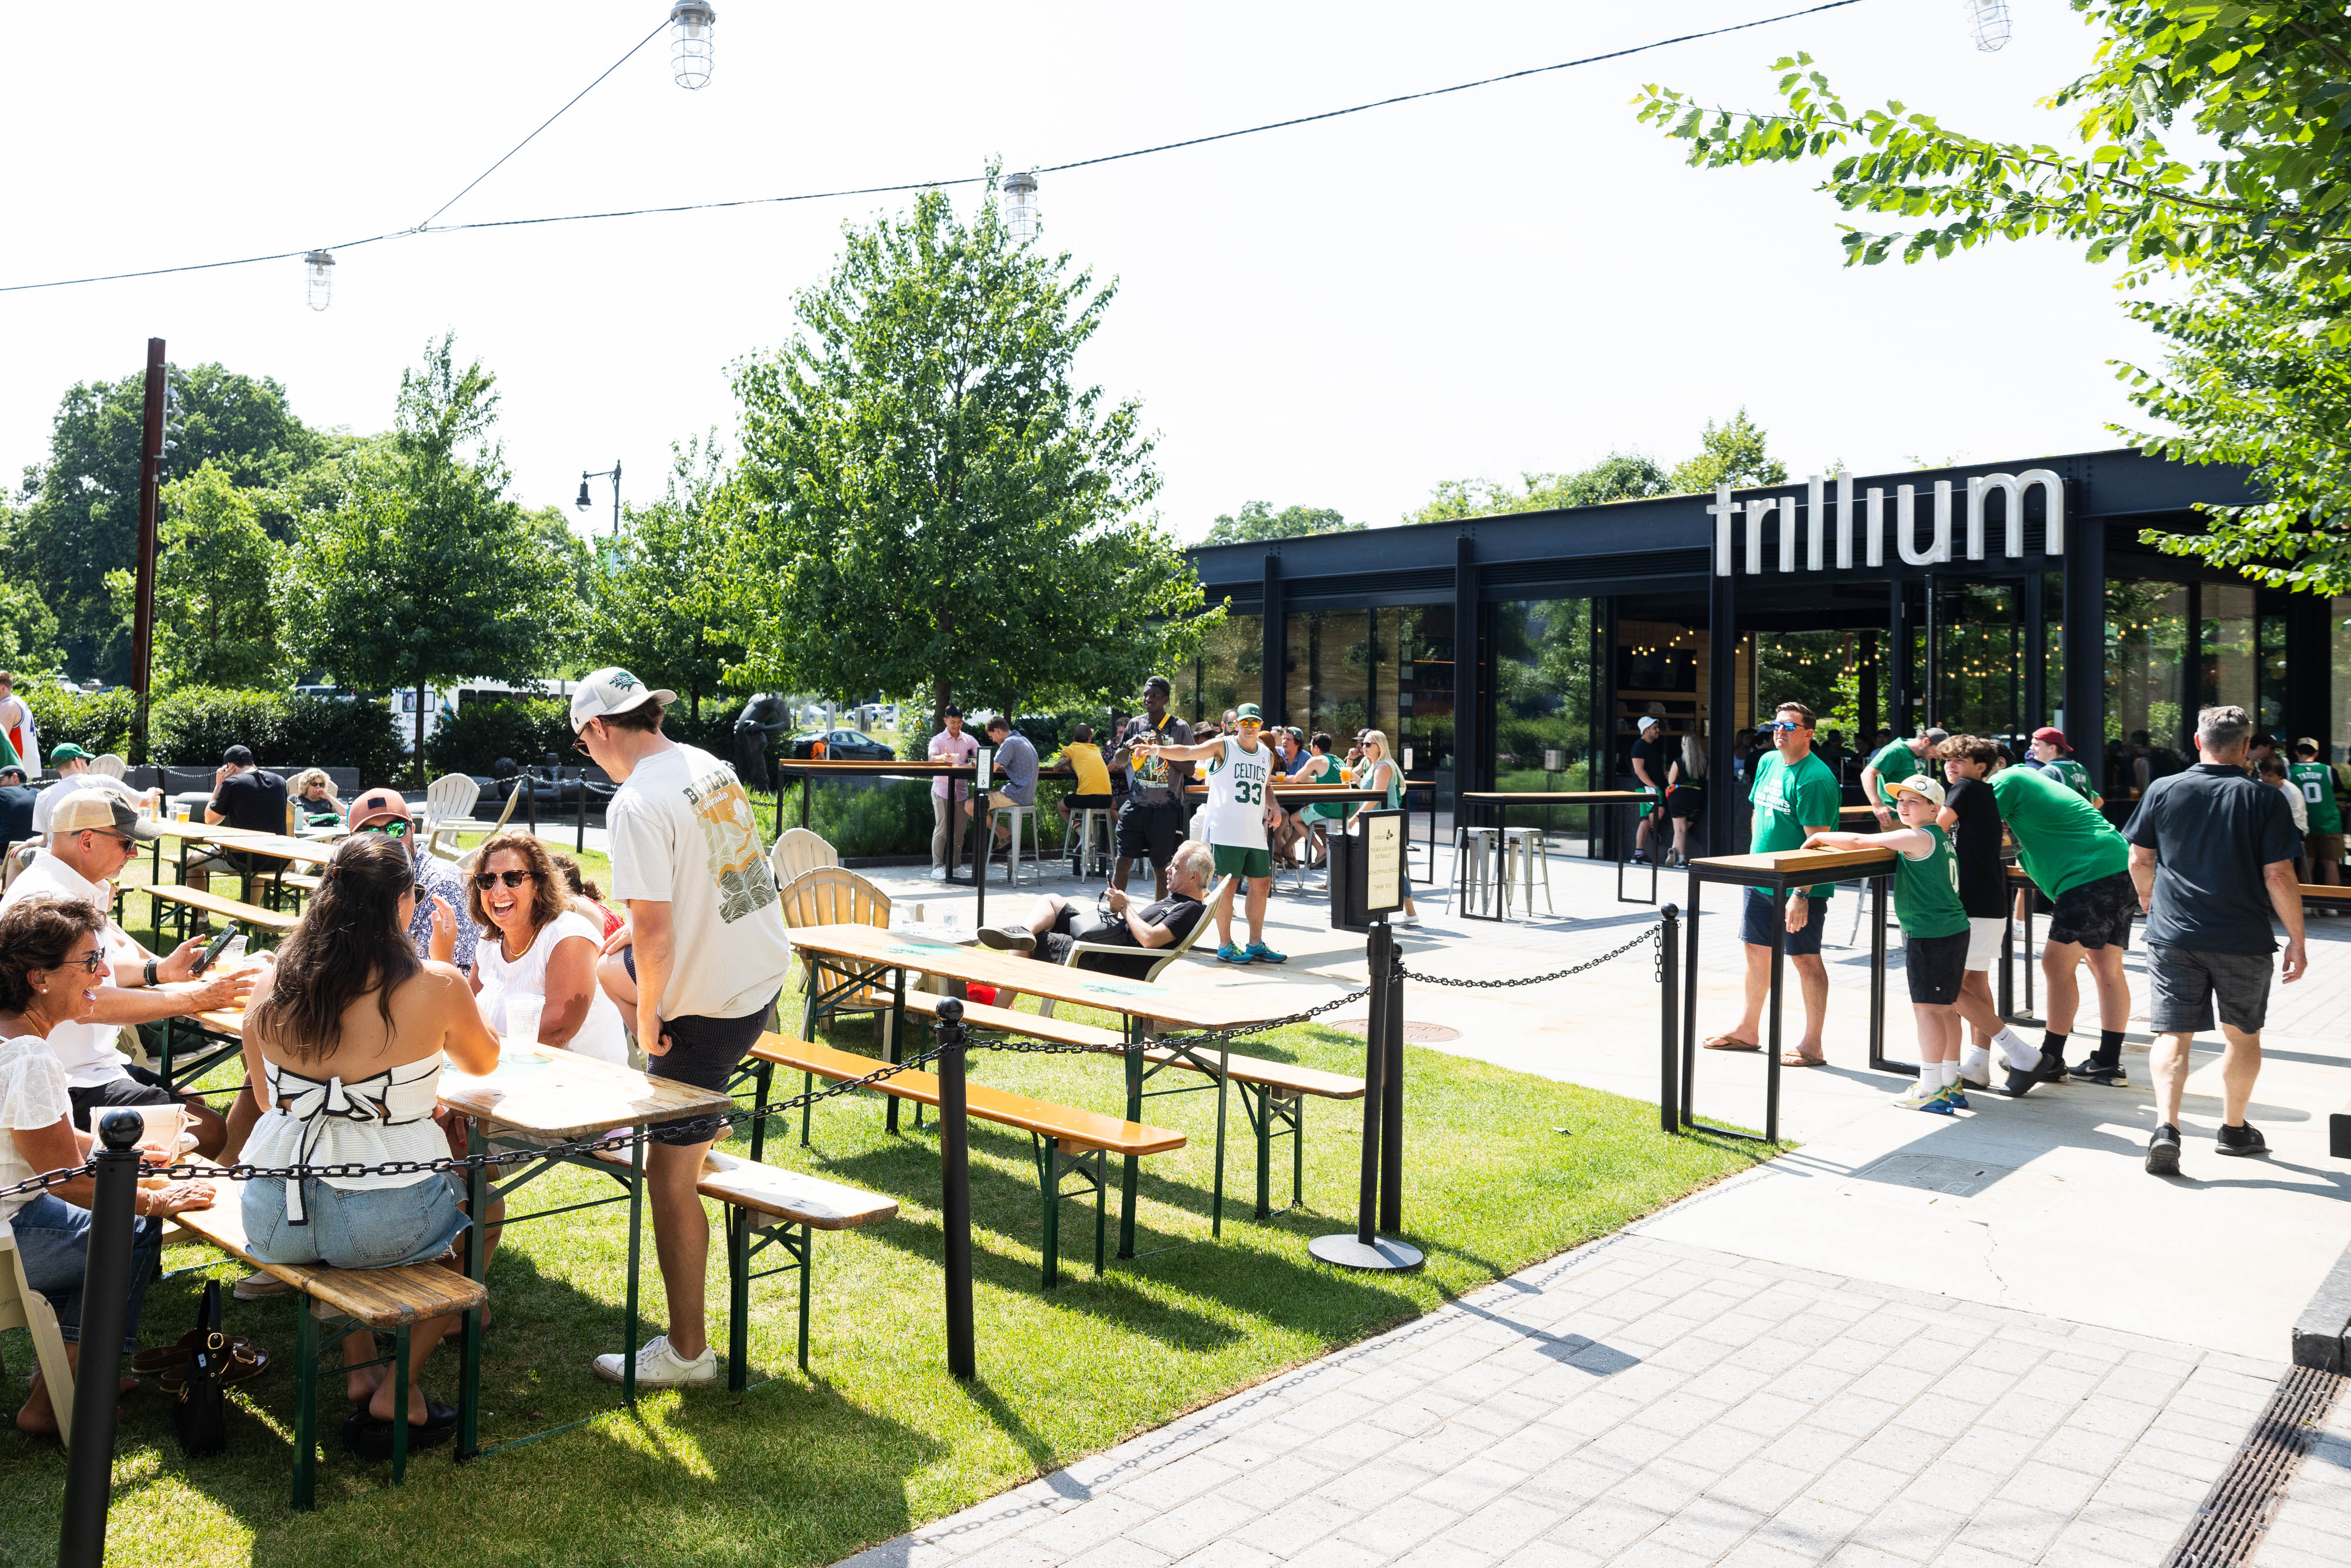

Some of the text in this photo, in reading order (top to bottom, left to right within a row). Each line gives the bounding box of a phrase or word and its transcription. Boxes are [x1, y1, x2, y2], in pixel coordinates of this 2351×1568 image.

[1706, 468, 2064, 577] trillium
[1234, 763, 1266, 783] CELTICS
[696, 792, 729, 815] Colorado
[1235, 780, 1262, 806] 33
[2302, 782, 2323, 803] 0
